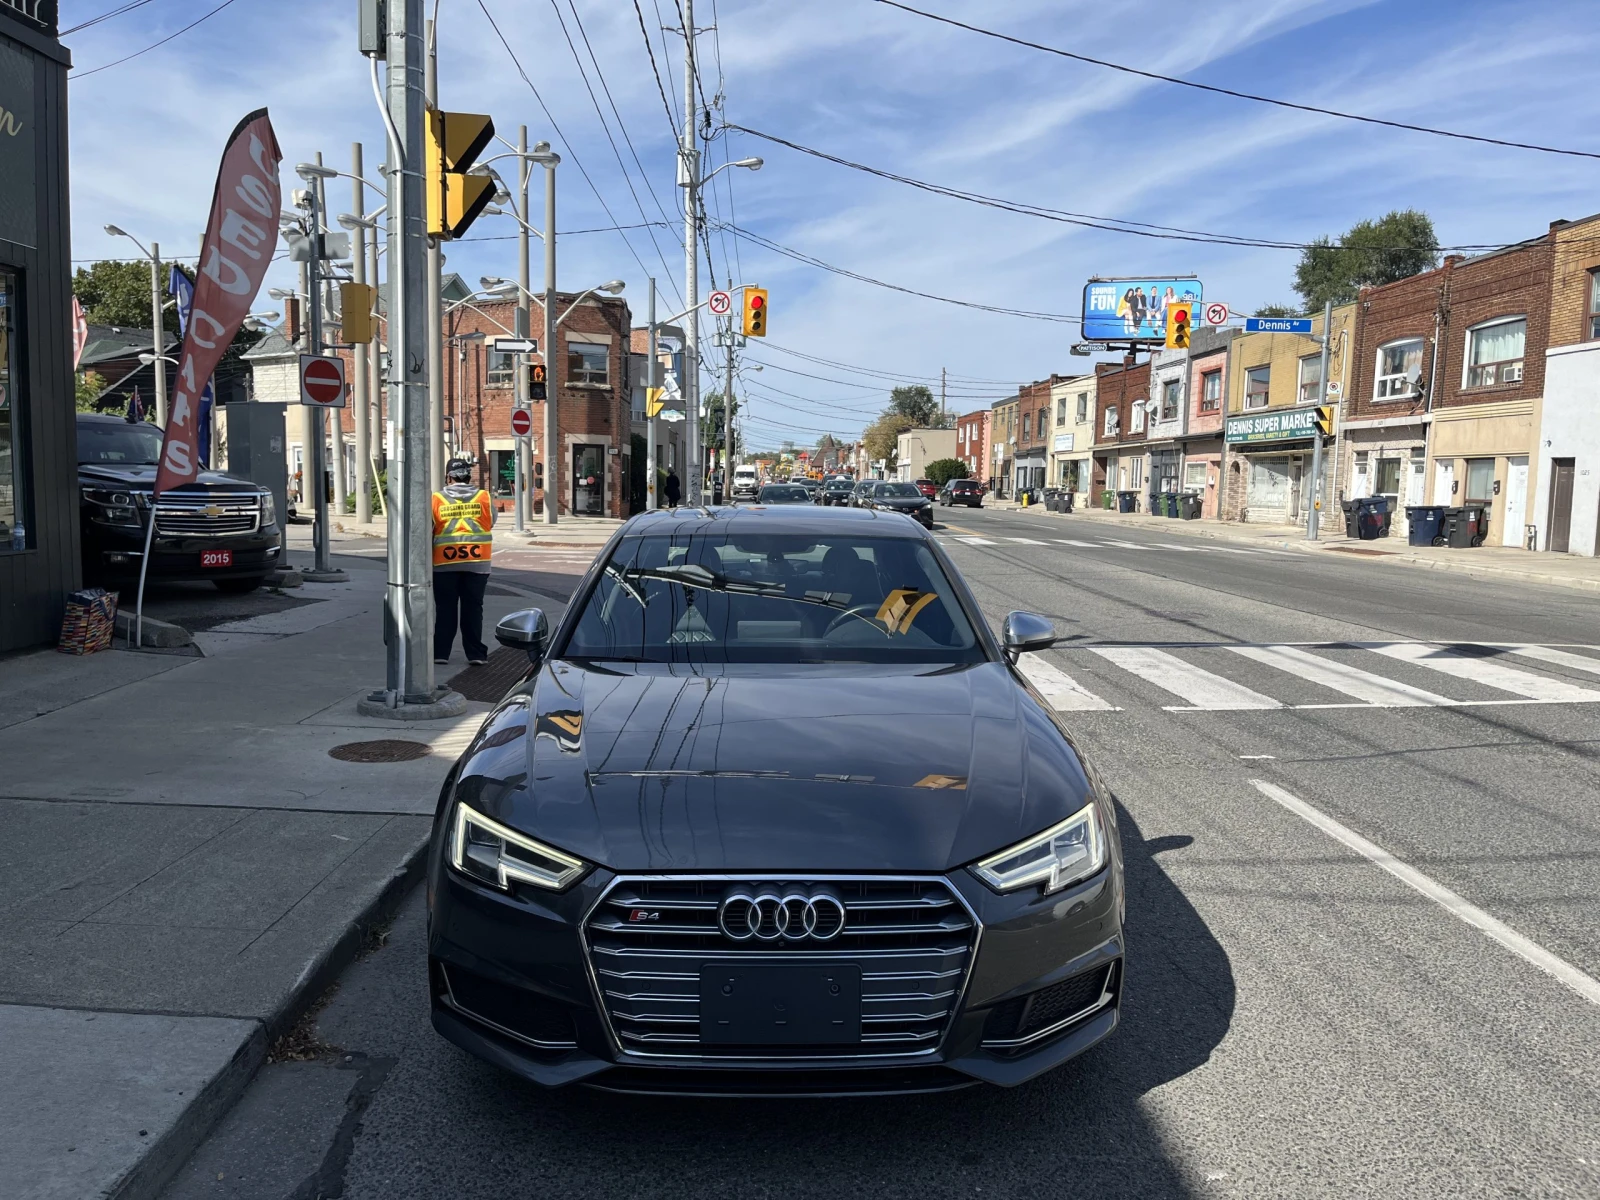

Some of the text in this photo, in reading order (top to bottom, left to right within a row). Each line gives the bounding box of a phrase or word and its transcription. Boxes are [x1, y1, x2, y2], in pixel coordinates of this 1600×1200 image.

[1091, 286, 1116, 295] SOUNDS
[1090, 295, 1116, 311] FUN
[1258, 320, 1291, 330] Dennis
[1227, 419, 1253, 435] DENNIS
[1254, 416, 1279, 432] SUPER
[203, 553, 229, 564] 2015
[636, 911, 660, 921] S4
